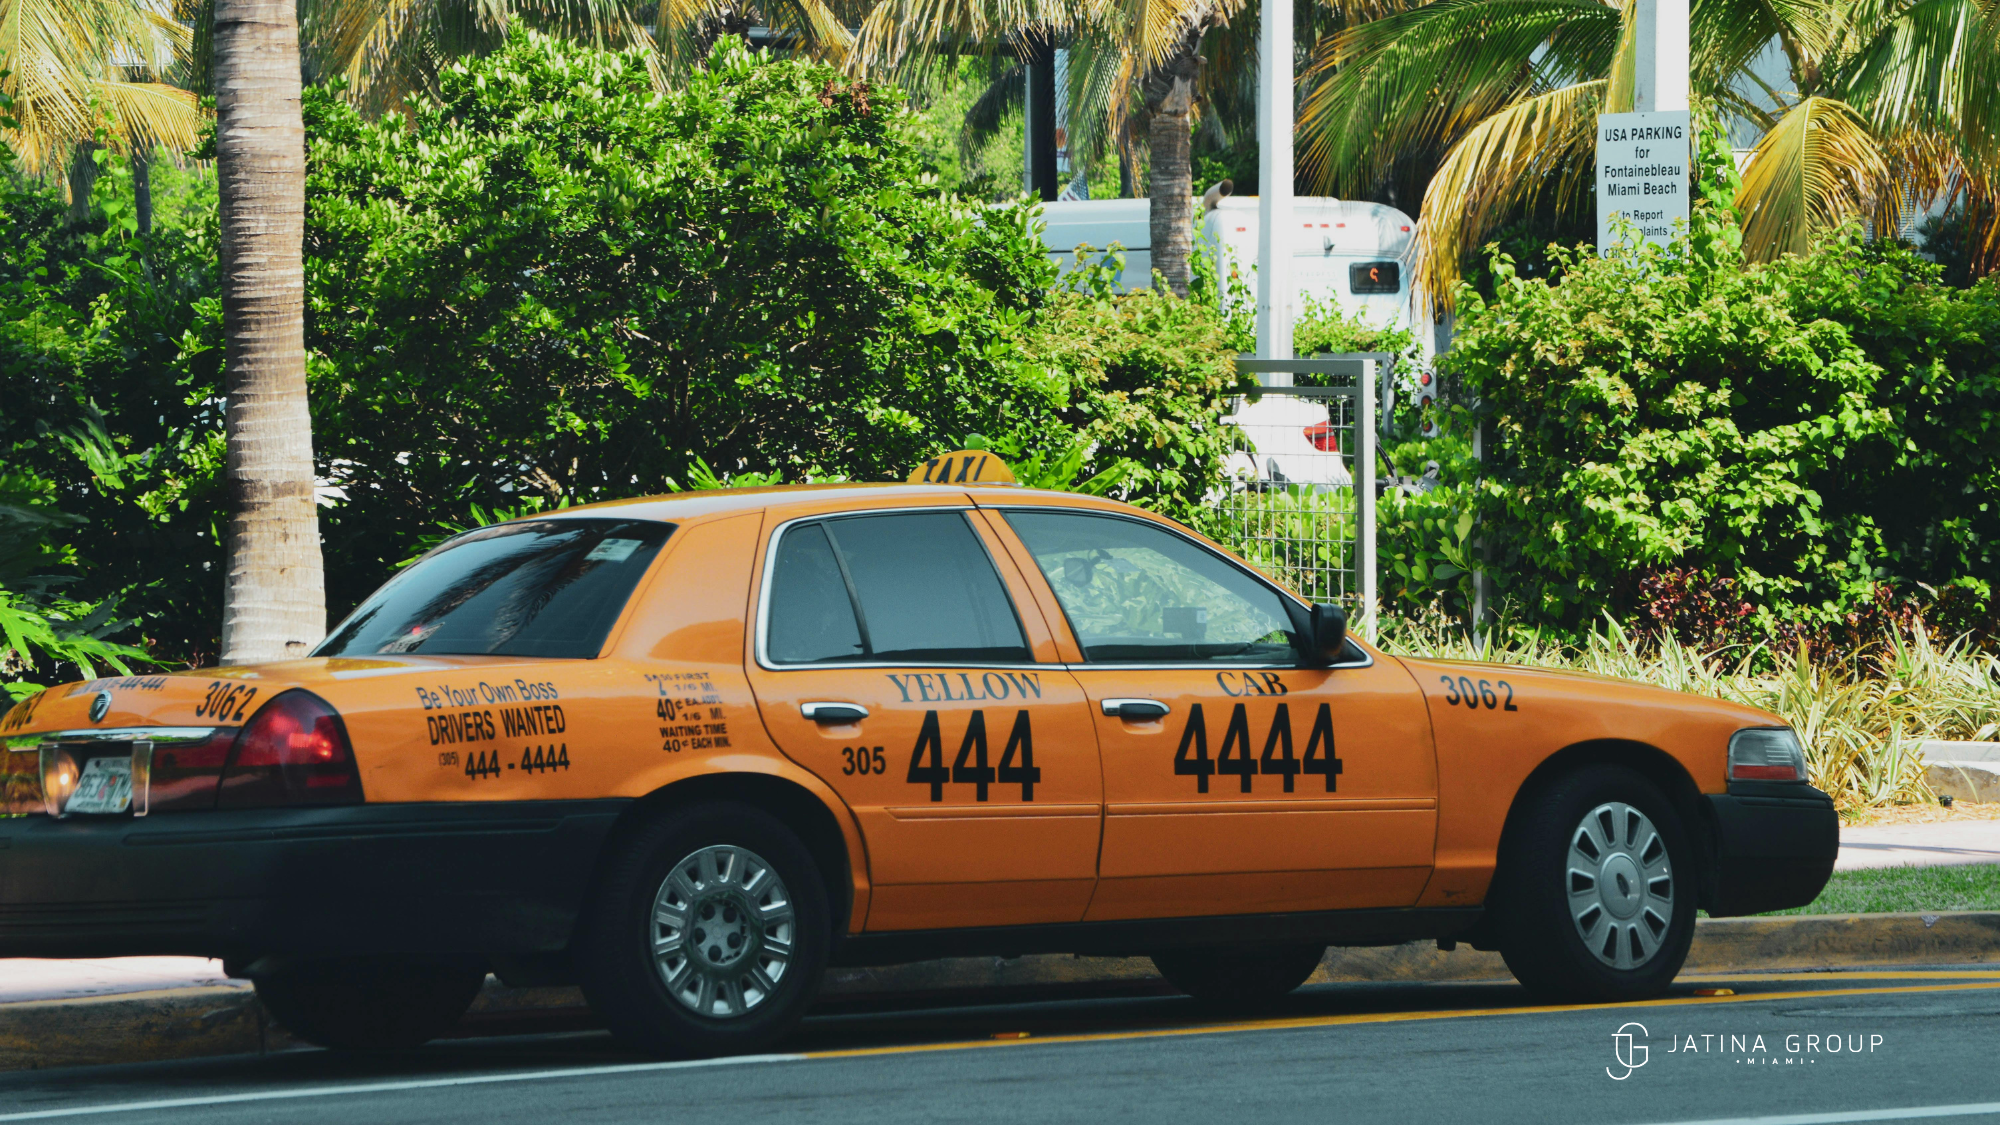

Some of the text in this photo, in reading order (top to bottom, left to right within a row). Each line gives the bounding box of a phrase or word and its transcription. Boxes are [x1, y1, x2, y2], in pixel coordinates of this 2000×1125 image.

[1605, 126, 1682, 142] USA PARKING
[1635, 146, 1650, 159] for
[1604, 164, 1681, 178] Fontainebleau
[1608, 182, 1677, 196] Miami Beach
[1633, 210, 1663, 222] Report
[923, 456, 988, 483] TAXI
[674, 672, 710, 680] FIRST
[885, 671, 1288, 702] YELLOW CAB
[196, 681, 258, 722] 3062
[415, 679, 559, 710] Be Your Own Boss
[1440, 675, 1518, 712] 3062
[427, 705, 566, 746] DRIVERS WANTED
[659, 723, 727, 738] WAITING TIME
[691, 737, 713, 749] EACH
[842, 702, 1343, 802] 305 444 4444
[438, 751, 460, 768] (305)
[465, 749, 501, 781] 444
[520, 743, 570, 775] 4444
